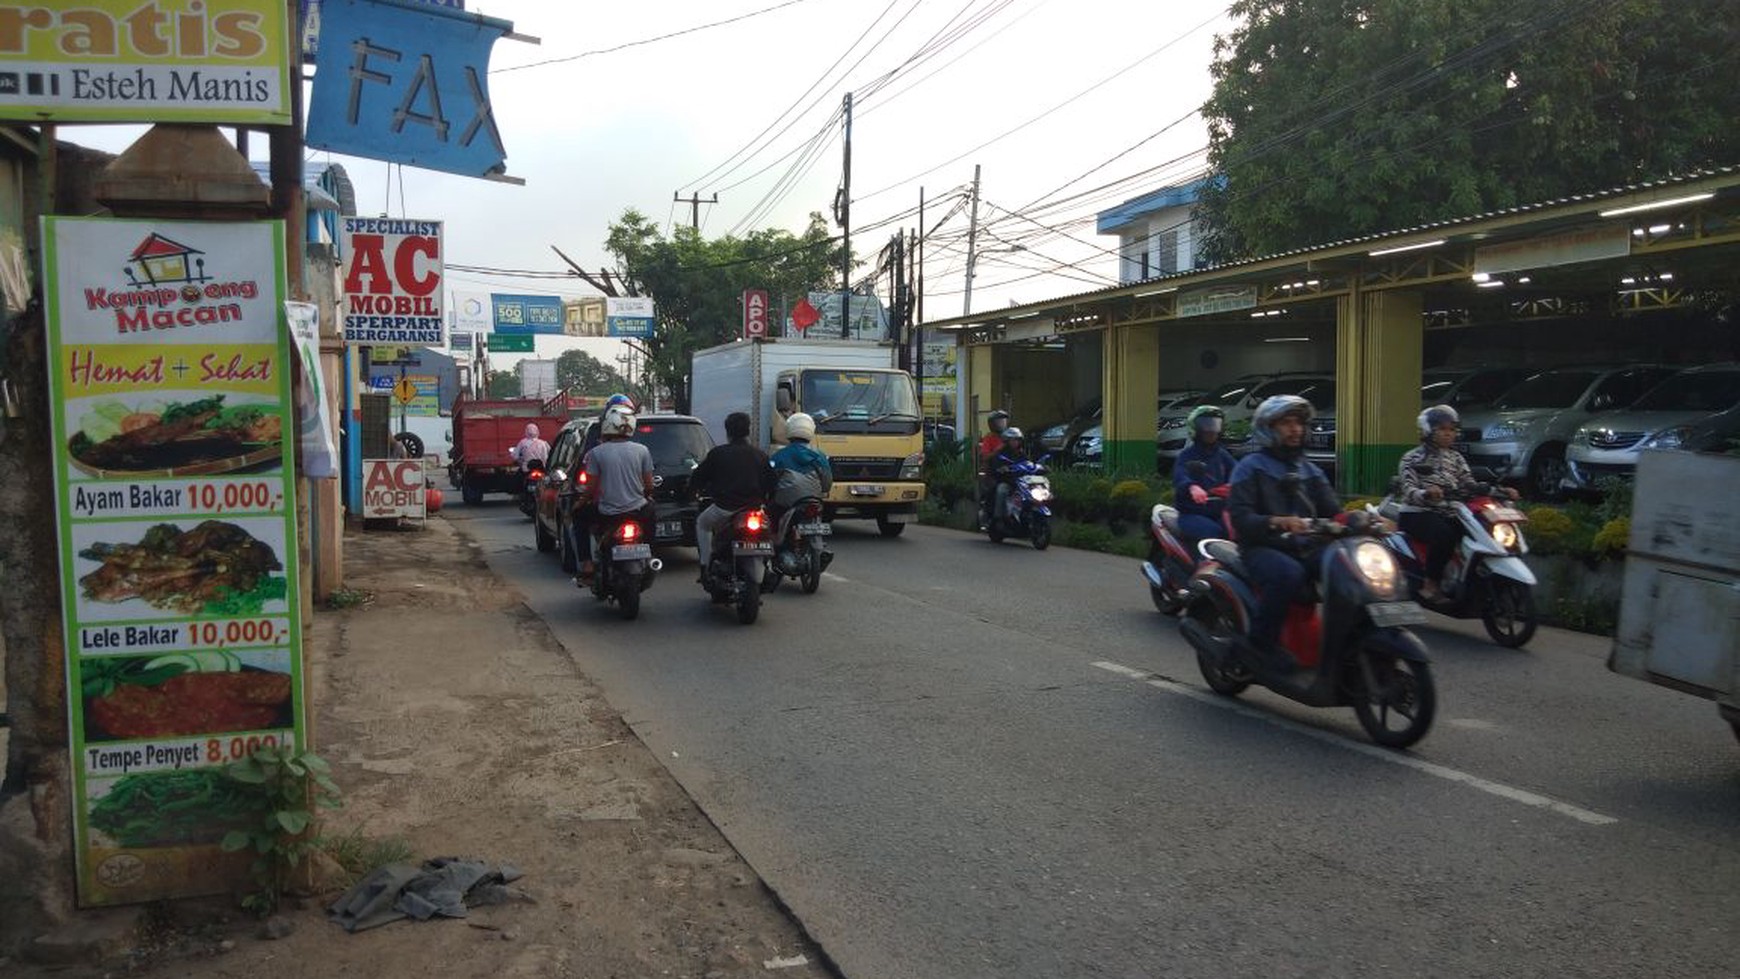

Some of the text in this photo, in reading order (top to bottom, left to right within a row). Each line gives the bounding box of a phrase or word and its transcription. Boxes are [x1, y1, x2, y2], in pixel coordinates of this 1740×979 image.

[71, 67, 269, 102] Esteh Manis
[347, 37, 508, 159] FAX
[346, 219, 438, 236] SPECIALIST
[344, 234, 440, 297] AC
[115, 302, 242, 334] Macan
[350, 295, 439, 316] MOBIL
[345, 316, 441, 330] SPERPART
[345, 329, 441, 342] BERGARANSI
[70, 350, 164, 387] Hemat
[200, 353, 271, 383] Sehat
[365, 460, 423, 491] AC
[75, 482, 284, 515] Ayam Bakar 10,000,-
[365, 490, 423, 507] MOBIL
[82, 619, 288, 649] Lele Bakar 10,000,-
[89, 747, 142, 771] Tempe
[146, 742, 199, 769] Penyet
